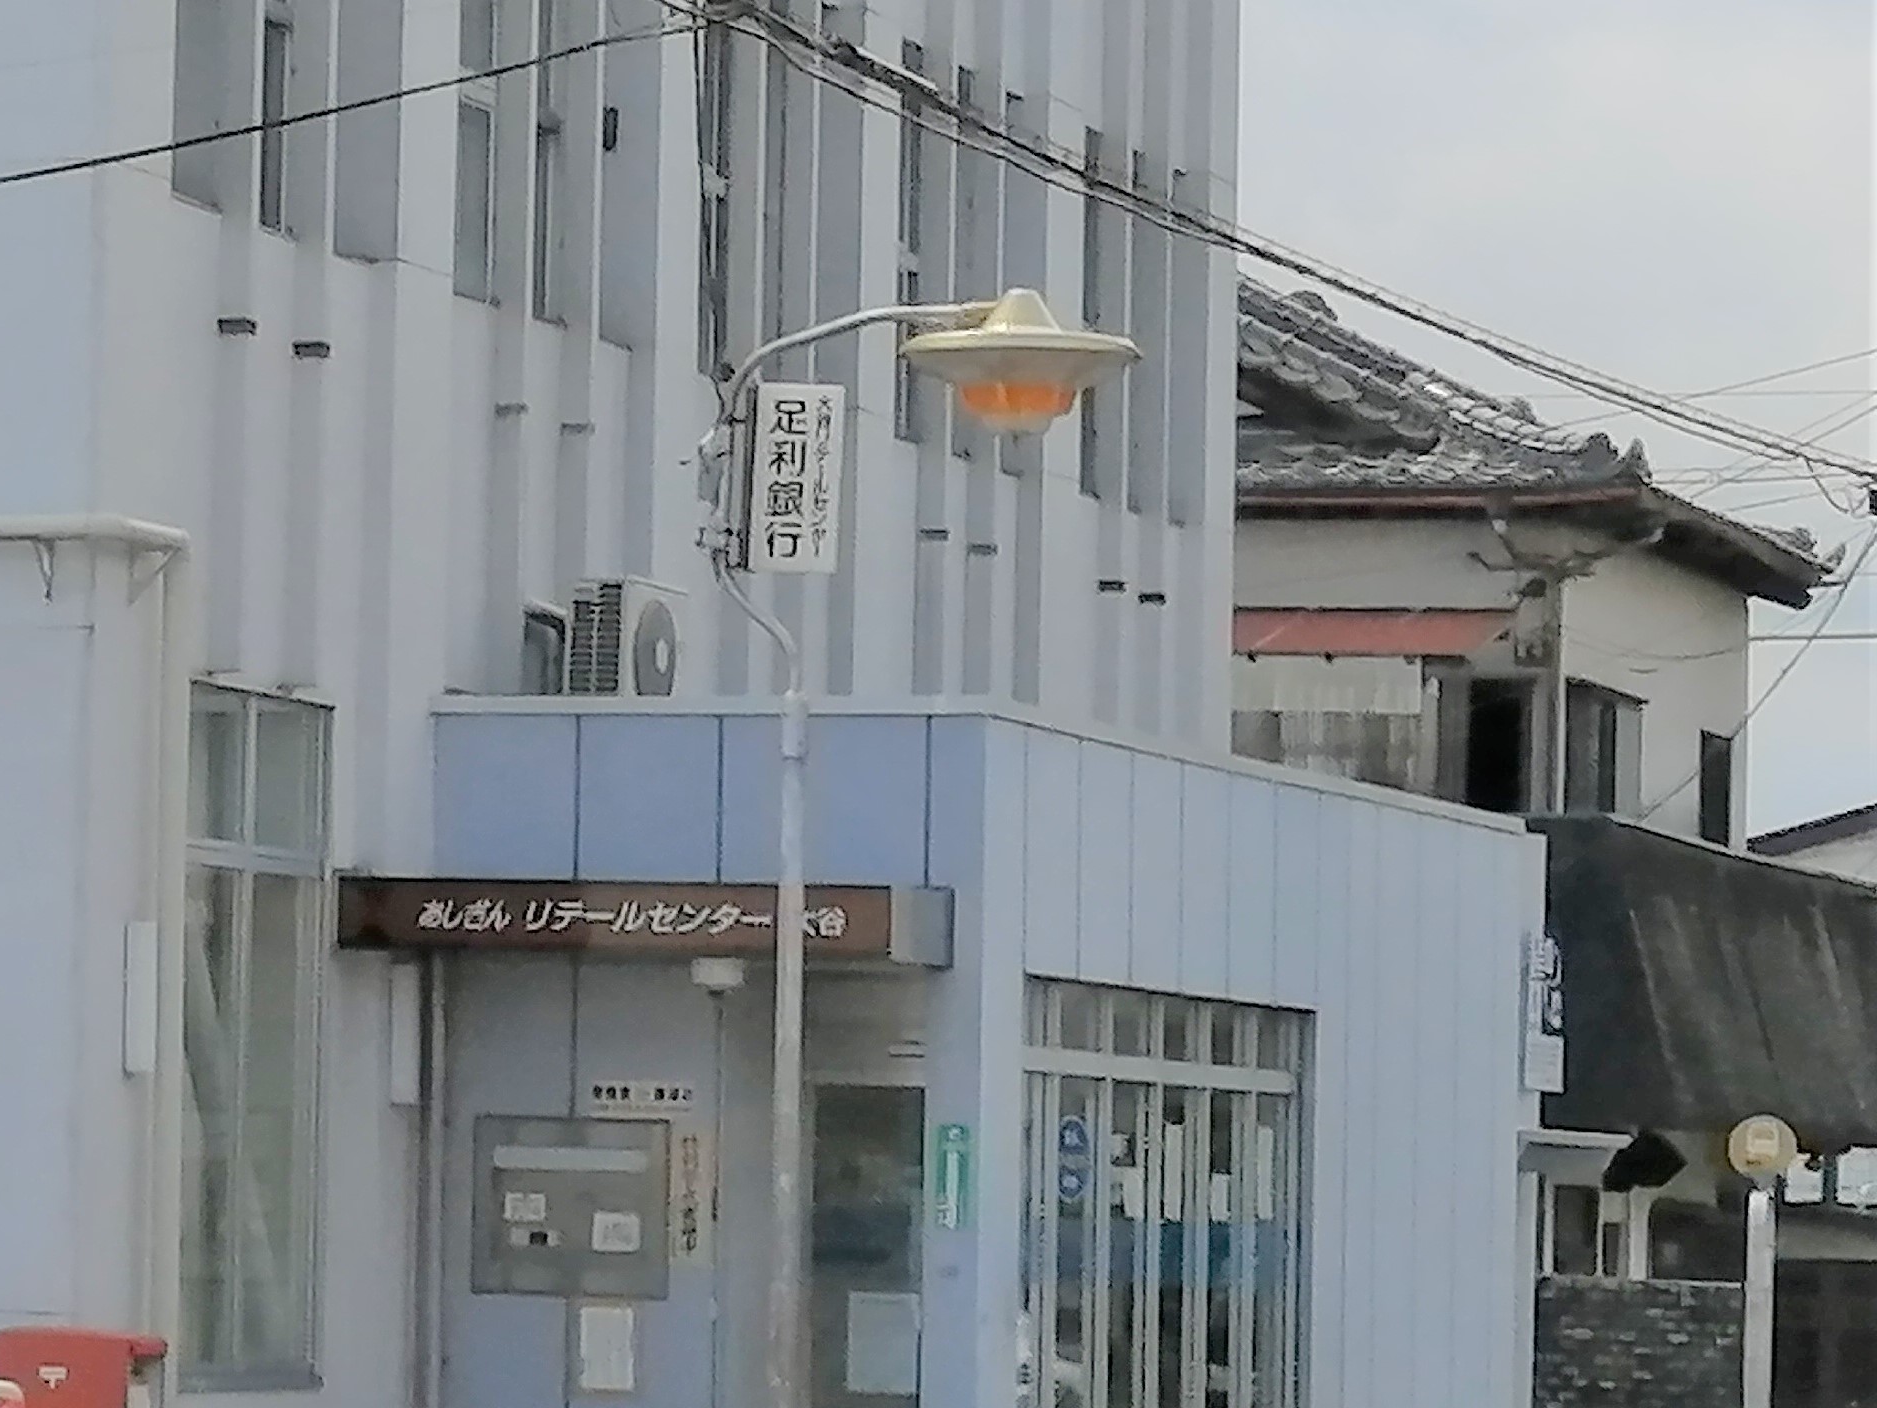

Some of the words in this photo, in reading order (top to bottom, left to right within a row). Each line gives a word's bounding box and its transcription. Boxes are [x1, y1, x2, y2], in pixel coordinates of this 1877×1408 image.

[765, 400, 809, 558] 足利銀行
[418, 898, 513, 933] あしぎん
